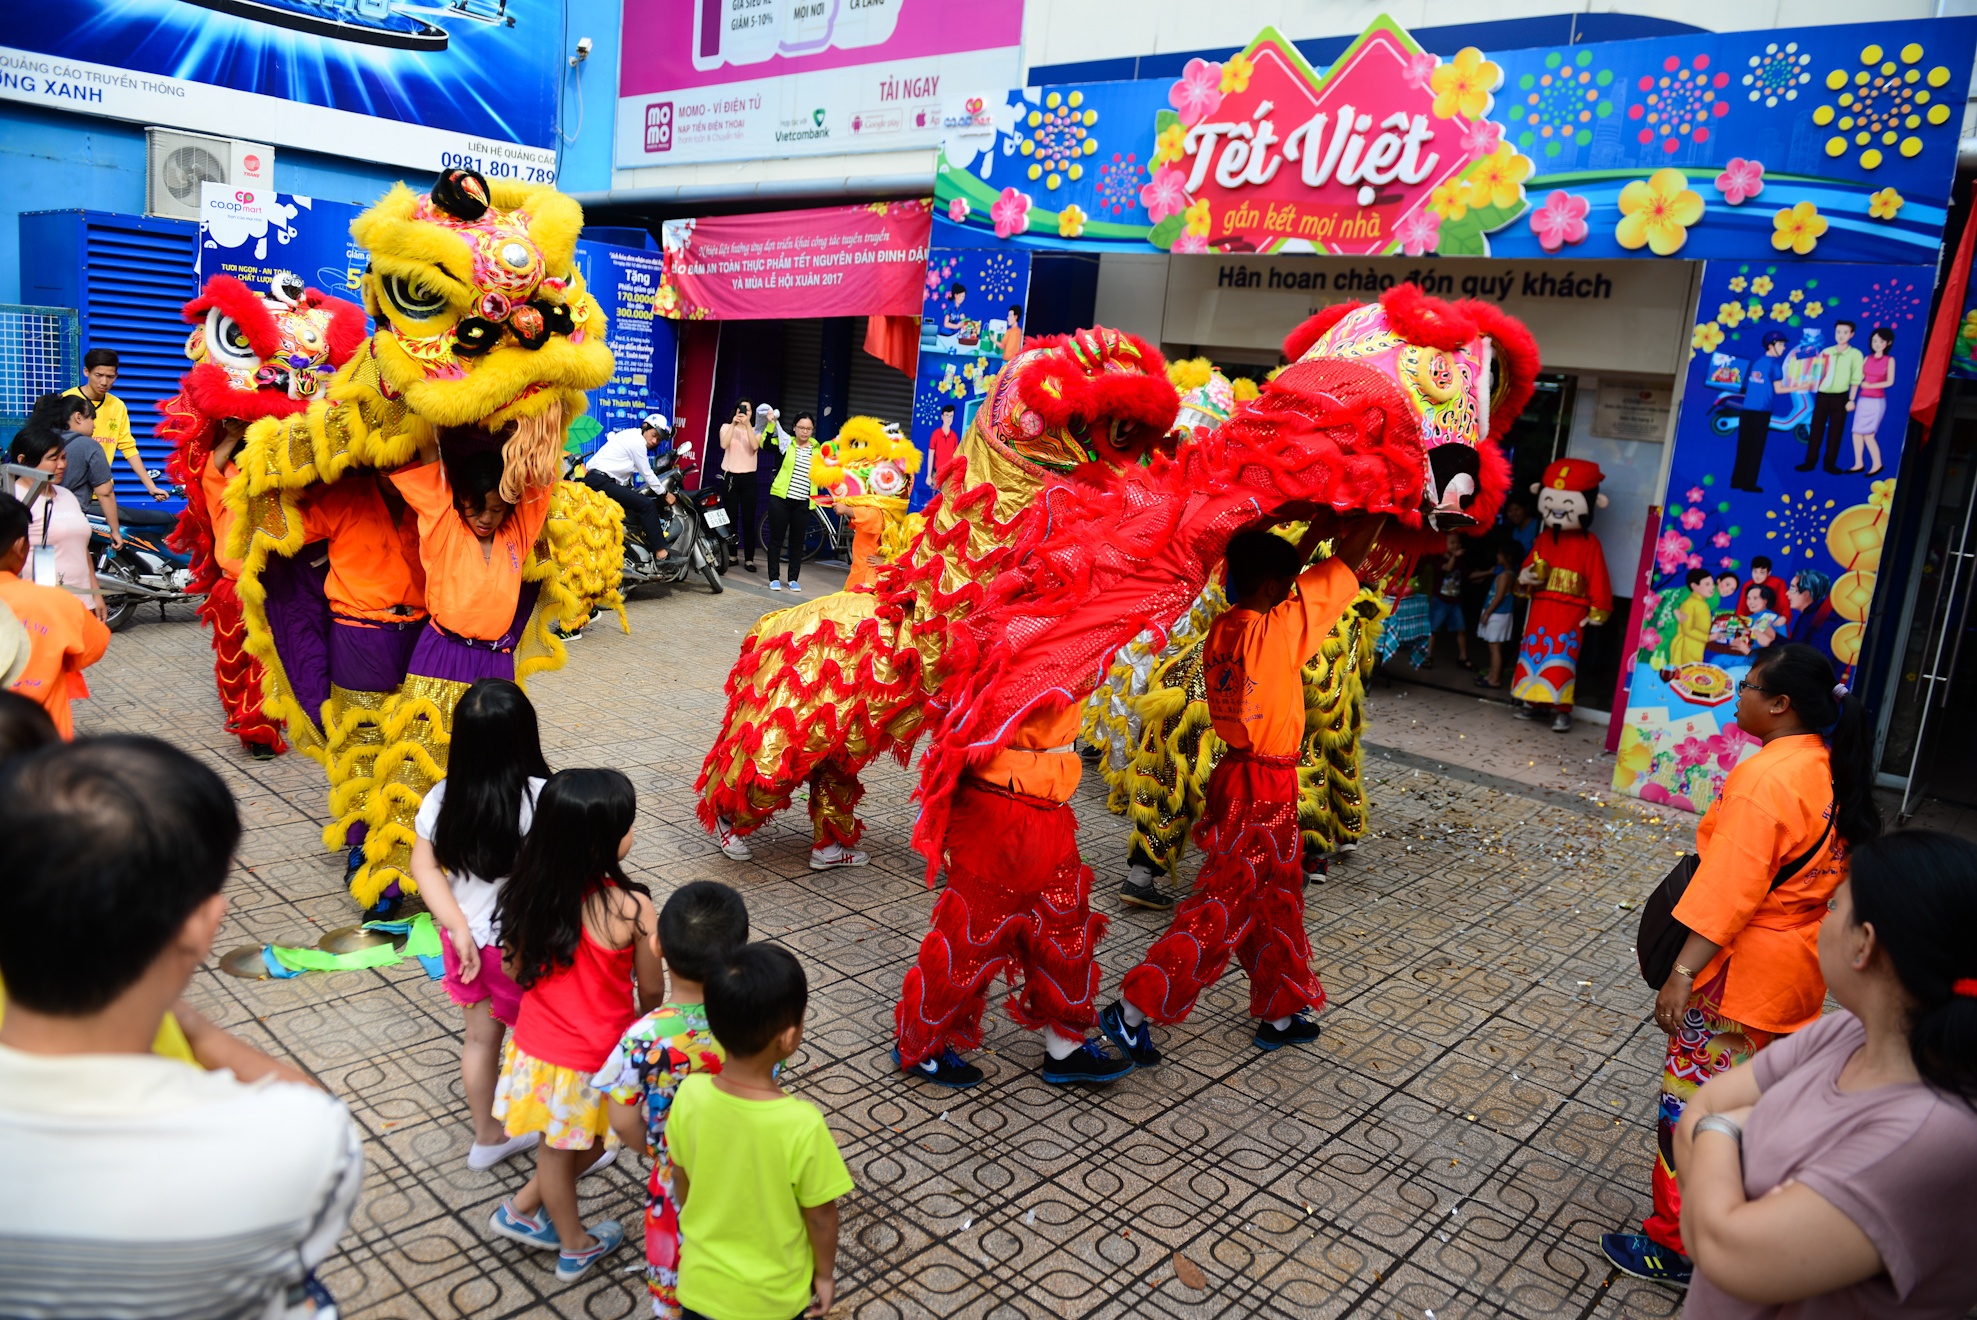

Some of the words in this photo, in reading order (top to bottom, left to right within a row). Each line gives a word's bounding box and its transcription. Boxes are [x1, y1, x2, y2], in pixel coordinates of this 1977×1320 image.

[731, 15, 749, 30] GIẢM
[751, 12, 773, 27] 5-10%
[793, 7, 808, 22] MỌI
[810, 3, 825, 17] NƠI
[0, 55, 49, 74] QUẢNG
[53, 64, 82, 80] CÁO
[84, 70, 138, 89] TRUYỀN
[141, 81, 185, 98] THÔNG
[0, 70, 36, 93] NG
[44, 79, 102, 103] XANH
[880, 75, 899, 101] TẢI
[903, 76, 940, 99] NGAY
[678, 104, 706, 118] MOMO
[713, 100, 722, 114] VÍ
[724, 99, 746, 115] ĐIỆN
[748, 93, 762, 110] TỬ
[677, 124, 690, 134] NẠP
[692, 121, 706, 132] TIỀN
[708, 121, 723, 132] ĐIỆN
[725, 119, 744, 130] THOẠI
[775, 127, 830, 143] Vietcombank
[468, 140, 488, 154] LIÊN
[490, 146, 502, 157] HỆ
[504, 148, 536, 162] QUẢNG
[538, 153, 555, 166] CÁO
[1182, 99, 1283, 195] Tết
[1282, 104, 1440, 206] Việt
[441, 152, 556, 185] 0981.801.789
[1223, 200, 1260, 235] gắn
[1263, 202, 1298, 232] kết
[1298, 212, 1338, 242] mọi
[1339, 211, 1381, 238] nhà
[346, 250, 365, 260] Giảm
[706, 263, 717, 274] AN
[719, 259, 740, 273] TOÀN
[742, 258, 764, 274] THỰC
[767, 252, 791, 270] PHẨM
[794, 252, 811, 268] TẾT
[813, 250, 852, 267] NGUYÊN
[854, 248, 875, 265] ĐÁN
[877, 249, 906, 263] ĐINH
[221, 263, 237, 272] TƯƠI
[238, 265, 257, 274] NGON
[262, 267, 272, 275] AN
[625, 269, 650, 286] Tặng
[238, 273, 255, 282] CHẤT
[257, 275, 273, 284] LƯỢN
[732, 276, 743, 290] VÀ
[745, 275, 763, 290] MÙA
[765, 272, 776, 288] LỄ
[778, 273, 793, 289] HỘI
[795, 271, 820, 287] XUÂN
[822, 272, 843, 286] 2017
[1218, 265, 1262, 288] Hân
[1268, 266, 1327, 290] hoan
[1333, 267, 1395, 291] chào
[1461, 270, 1514, 301] quý
[1522, 270, 1612, 299] khách
[617, 291, 654, 304] 170.000đ
[618, 282, 633, 291] Phiếu
[634, 285, 646, 294] giảm
[647, 286, 655, 295] giá
[616, 307, 654, 320] 300.000đ
[621, 376, 632, 384] VIP
[599, 398, 611, 407] Thẻ
[612, 398, 631, 408] Thành
[632, 400, 645, 408] Viên
